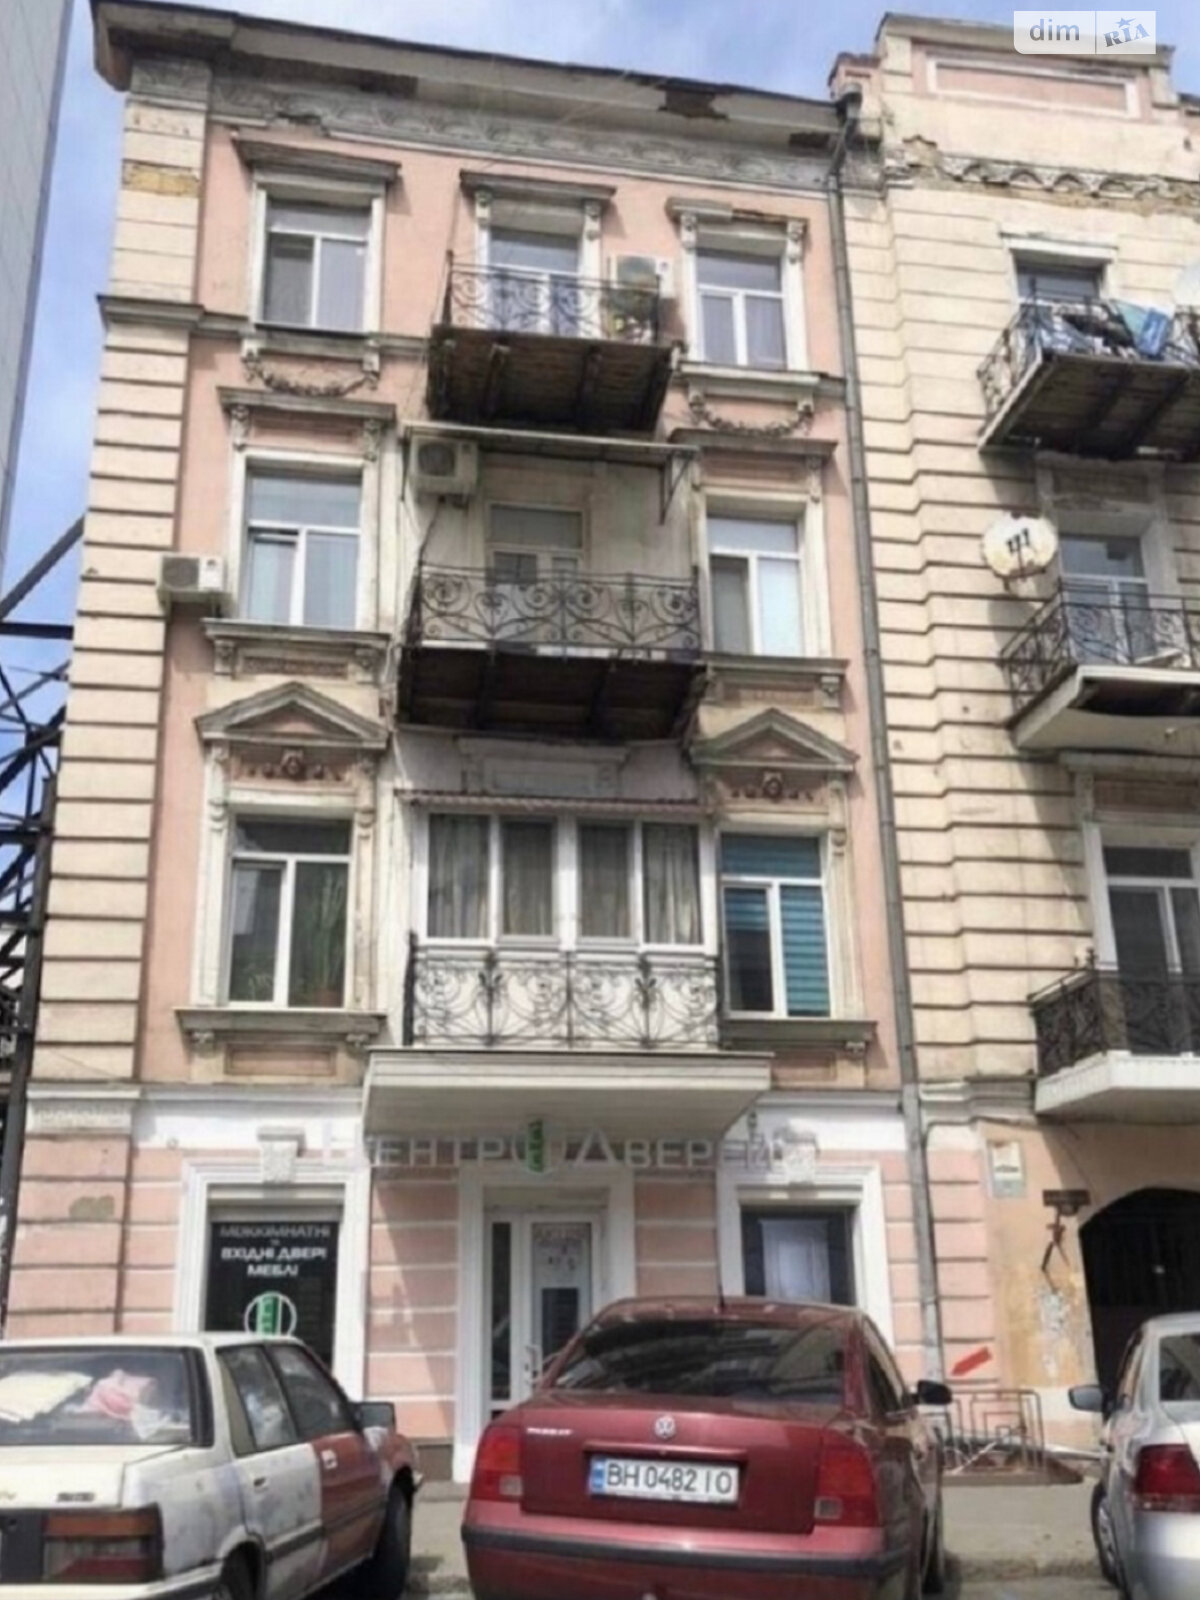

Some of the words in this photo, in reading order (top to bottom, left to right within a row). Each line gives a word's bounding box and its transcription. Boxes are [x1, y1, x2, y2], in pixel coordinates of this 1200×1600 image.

[247, 1264, 299, 1277] МЕБЛІ
[606, 1462, 640, 1488] BH
[643, 1465, 698, 1492] 0482
